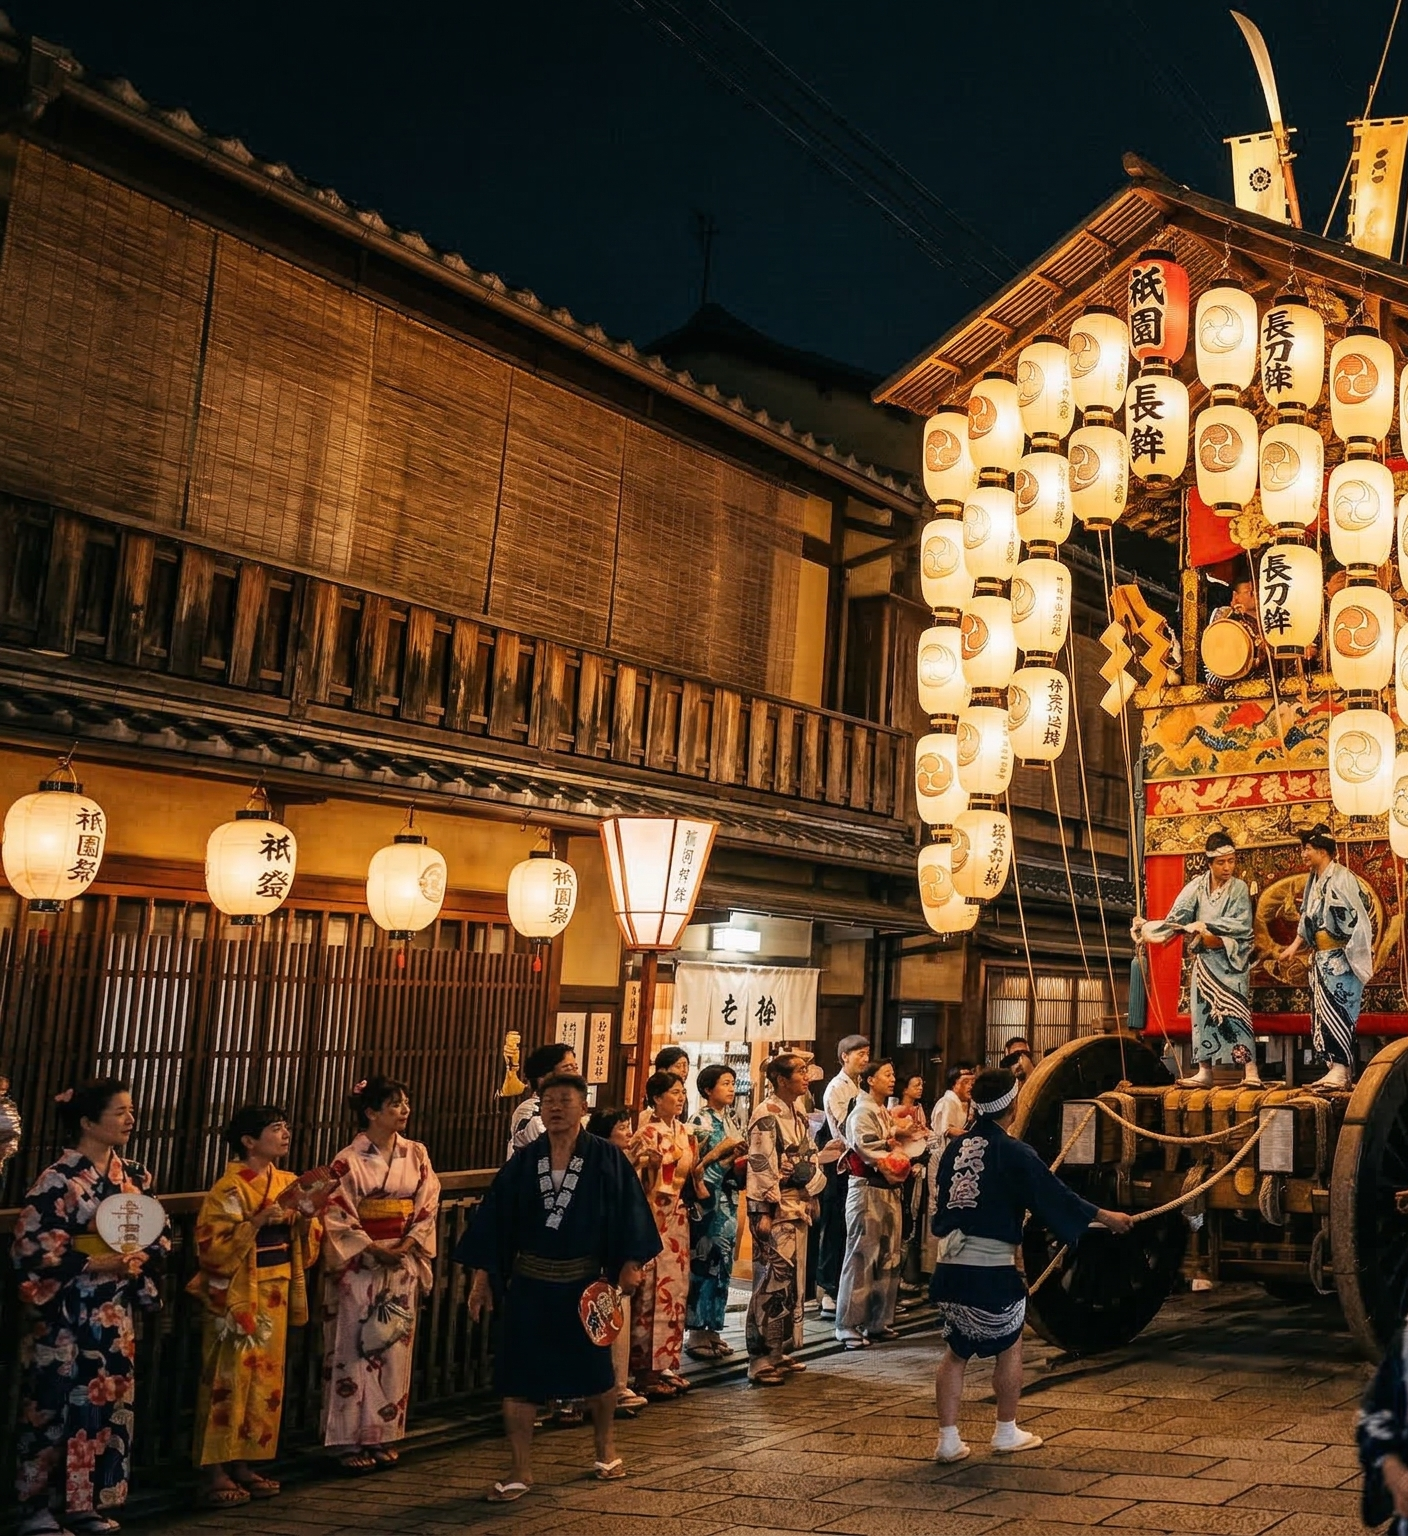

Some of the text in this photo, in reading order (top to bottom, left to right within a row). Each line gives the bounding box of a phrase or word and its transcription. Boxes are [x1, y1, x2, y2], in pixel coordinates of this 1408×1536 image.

[1129, 266, 1165, 348] 祇園
[1129, 383, 1166, 464] 長鉾
[1262, 554, 1293, 635] 長刀鉾
[67, 807, 104, 883] 祇園祭
[549, 867, 573, 924] 祇園祭
